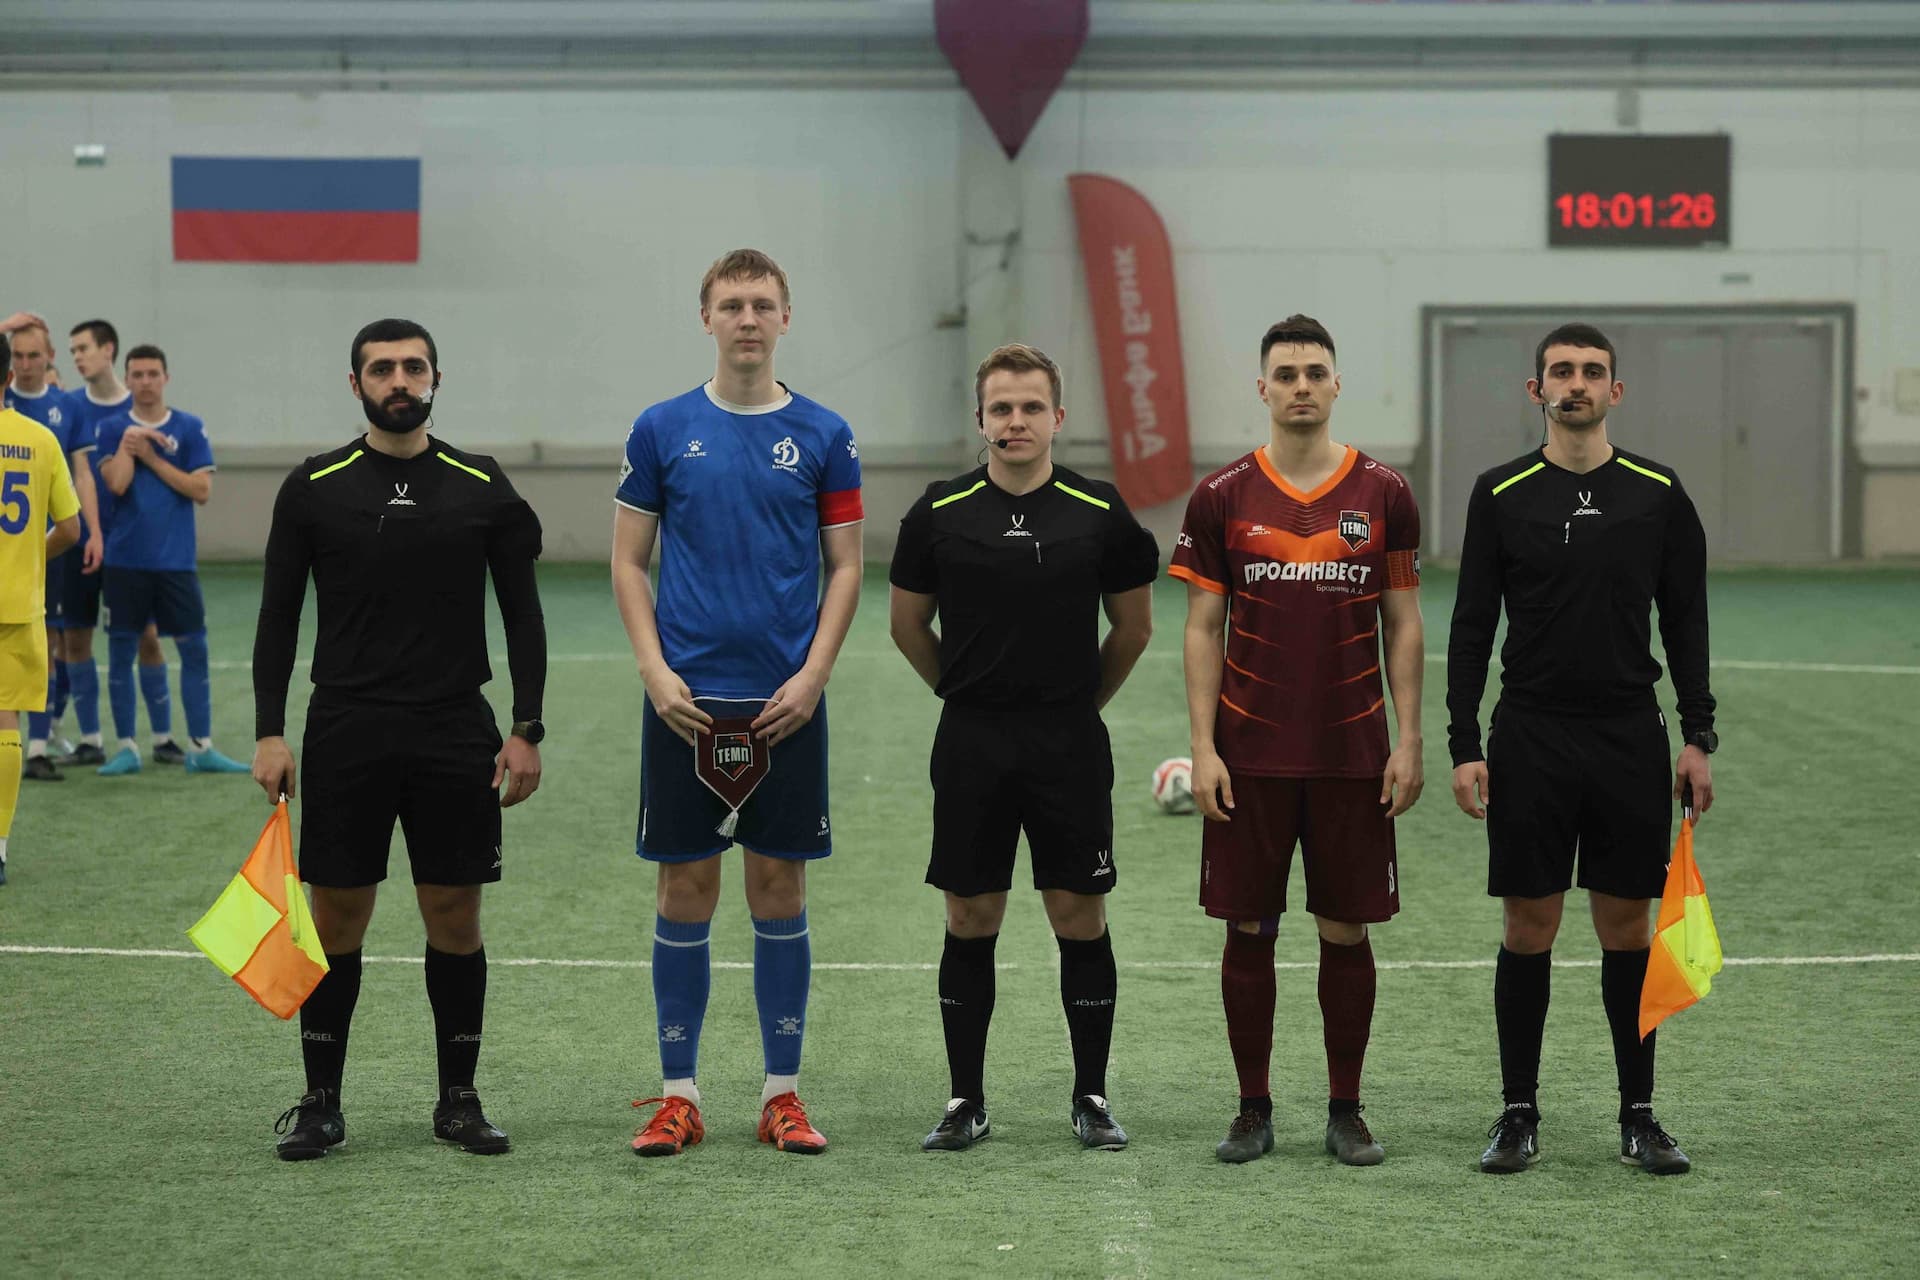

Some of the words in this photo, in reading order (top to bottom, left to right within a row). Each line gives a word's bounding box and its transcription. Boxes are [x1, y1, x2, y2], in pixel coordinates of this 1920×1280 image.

[1342, 521, 1368, 539] ТЕМП
[1244, 561, 1372, 585] ПРОДИНВЕСТ
[717, 747, 749, 763] ТЕМП
